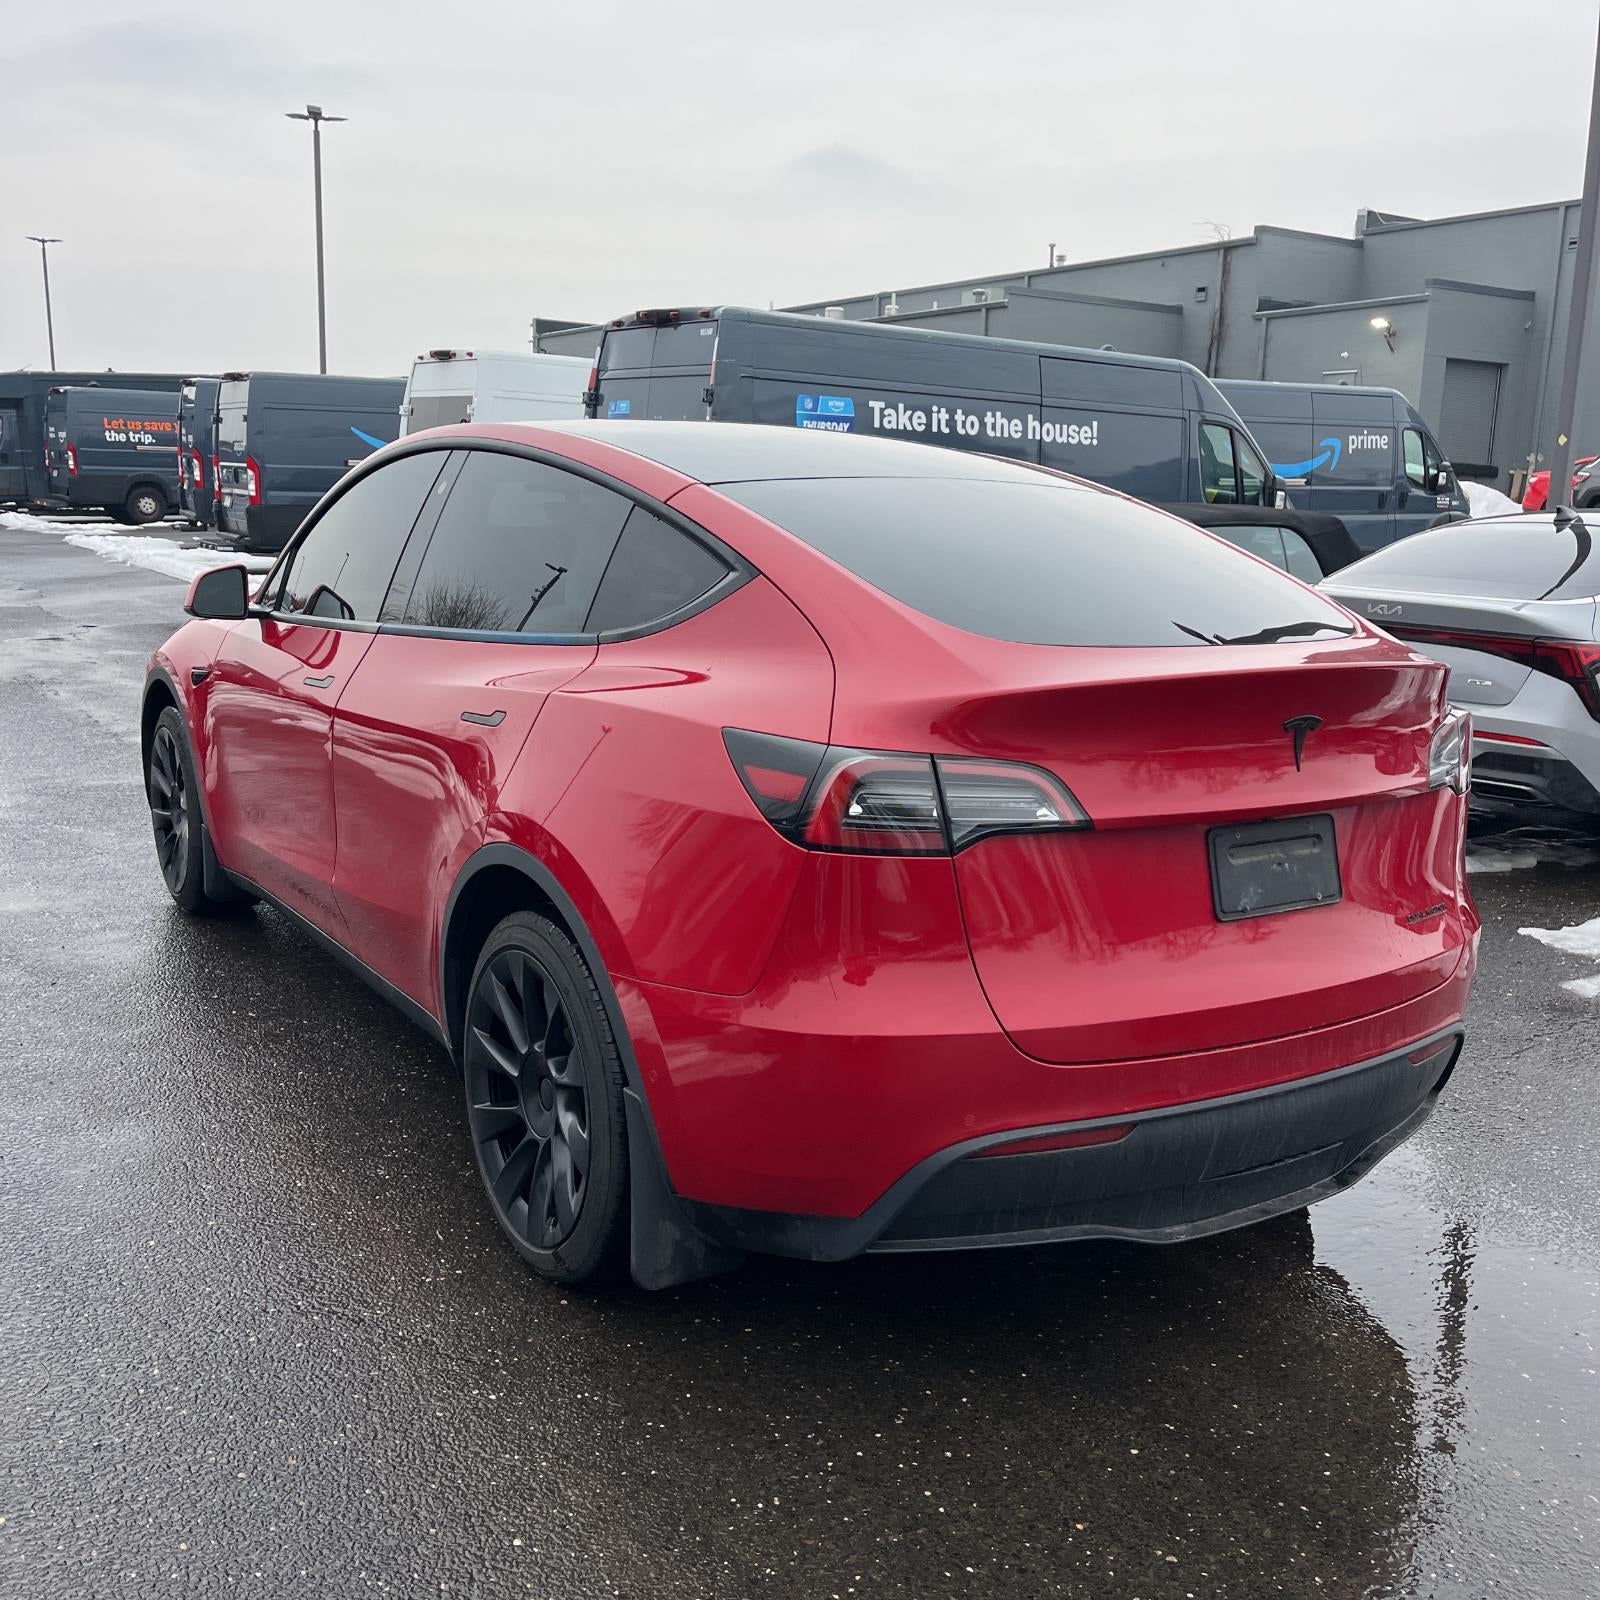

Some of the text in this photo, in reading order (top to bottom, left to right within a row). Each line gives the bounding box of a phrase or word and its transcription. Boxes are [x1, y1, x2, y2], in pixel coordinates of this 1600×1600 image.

[103, 417, 125, 429] Let
[127, 420, 141, 430] us
[144, 421, 172, 431] save
[803, 420, 850, 432] THURSDAY
[868, 400, 1098, 446] Take it to the house!
[104, 430, 156, 445] the trip.
[1348, 429, 1389, 454] prime
[1367, 603, 1402, 616] KIA
